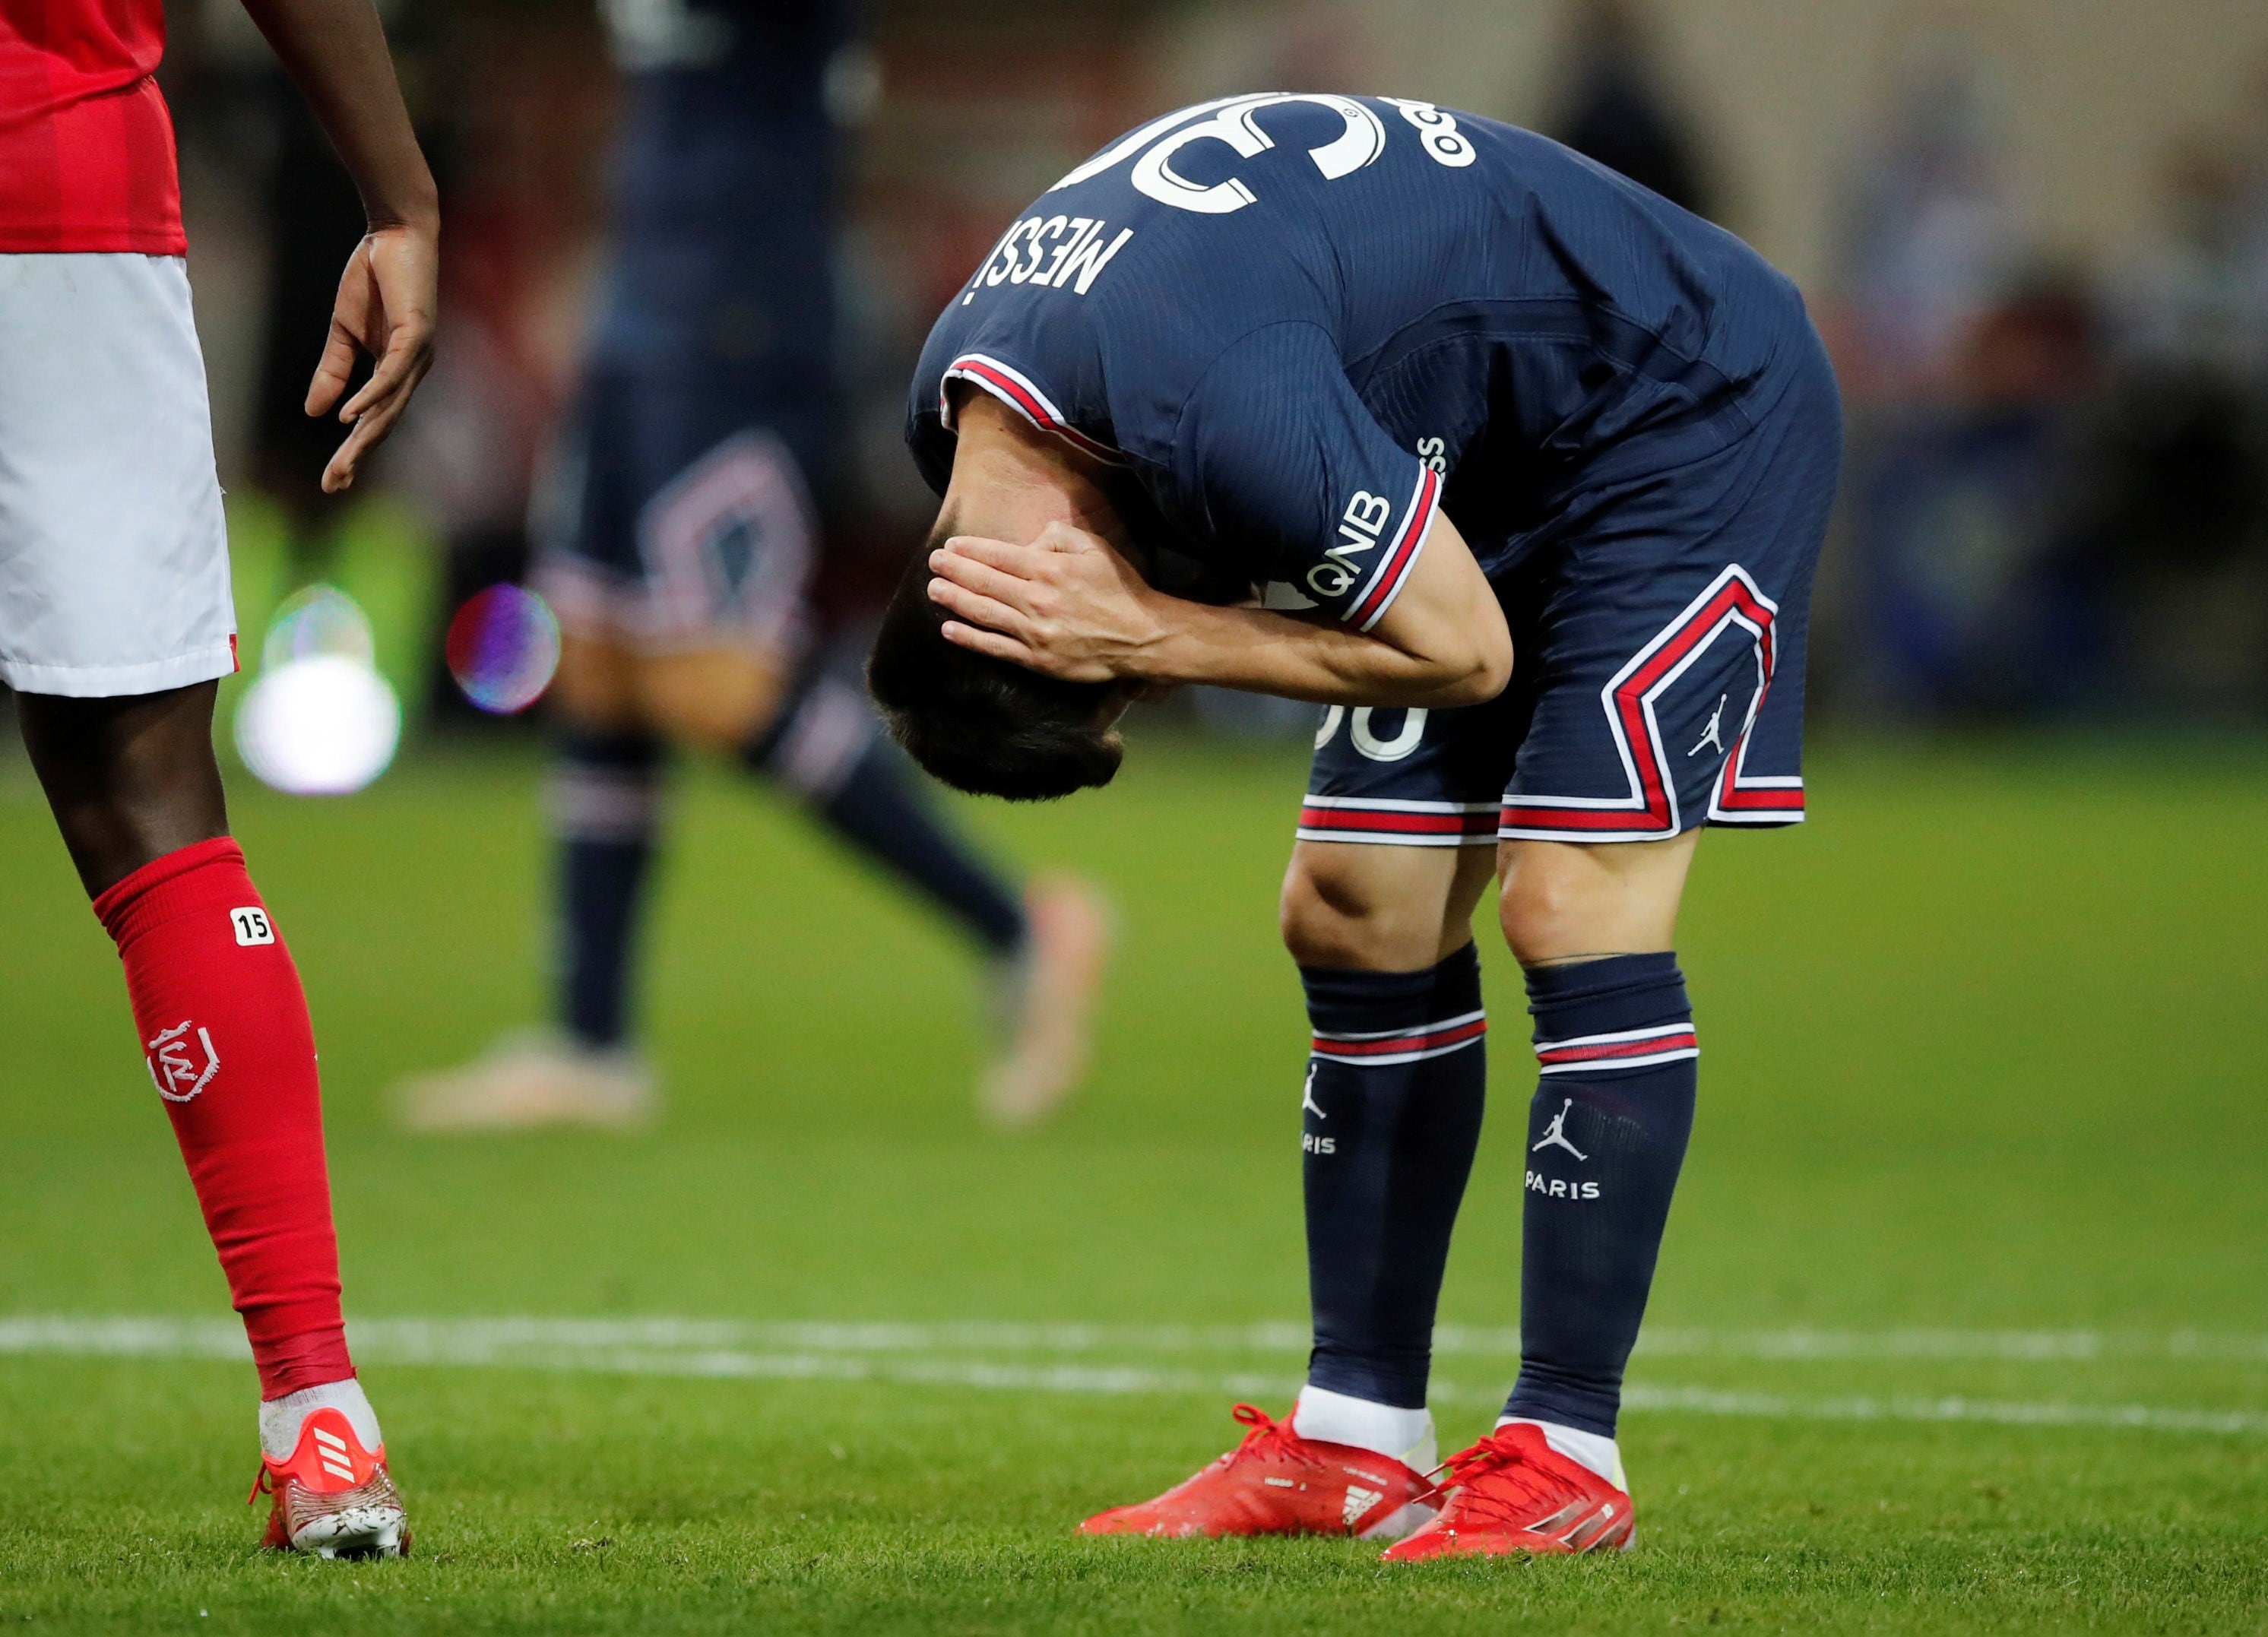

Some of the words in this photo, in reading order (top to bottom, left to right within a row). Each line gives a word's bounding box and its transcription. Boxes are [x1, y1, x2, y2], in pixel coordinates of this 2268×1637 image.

[961, 215, 1135, 306] MESSI
[1307, 490, 1391, 597] QNB
[238, 913, 268, 939] 15
[1525, 1170, 1601, 1200] PARIS
